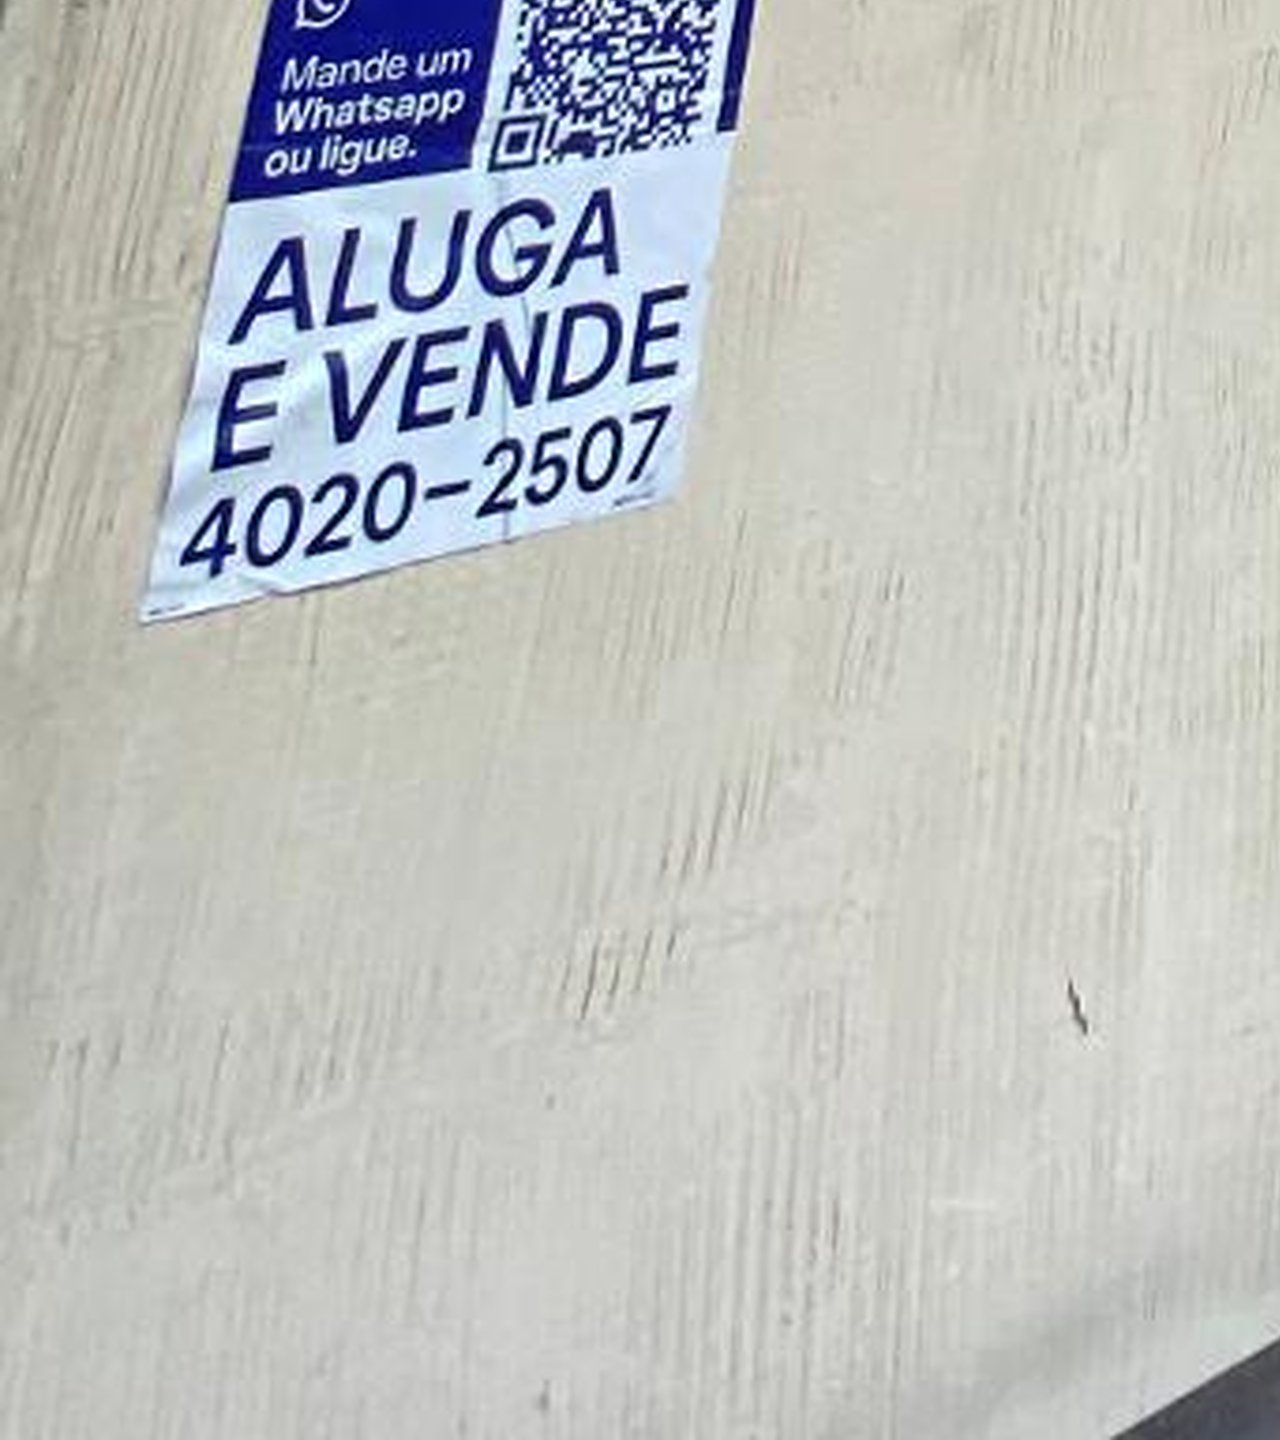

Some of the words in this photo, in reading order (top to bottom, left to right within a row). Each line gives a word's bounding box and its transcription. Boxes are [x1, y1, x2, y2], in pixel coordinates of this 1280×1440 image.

[275, 88, 466, 135] Whatsapp
[280, 48, 408, 93] Mande
[415, 48, 473, 76] um
[264, 147, 313, 178] ou
[317, 133, 418, 177] ligue.
[227, 187, 620, 345] ALUGA
[209, 359, 287, 474] E
[324, 283, 690, 446] VENDE
[180, 405, 673, 577] 4020-2507
